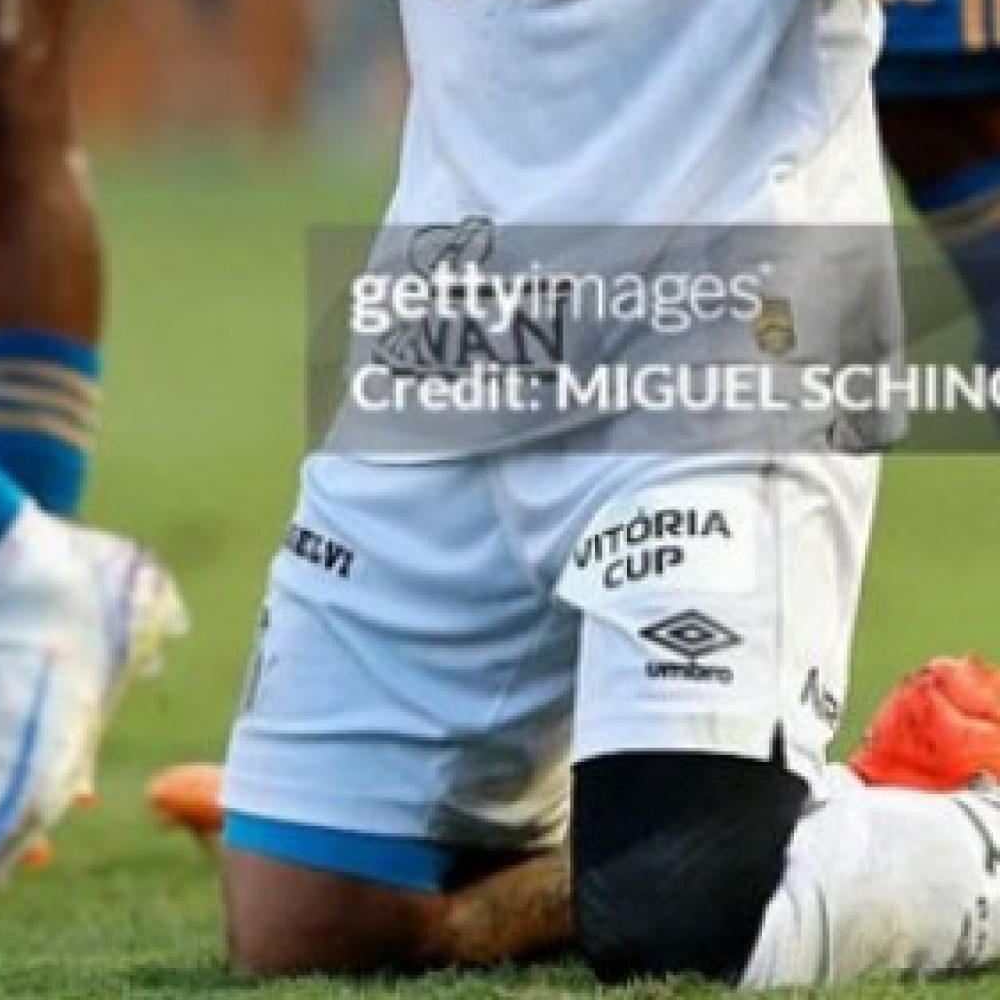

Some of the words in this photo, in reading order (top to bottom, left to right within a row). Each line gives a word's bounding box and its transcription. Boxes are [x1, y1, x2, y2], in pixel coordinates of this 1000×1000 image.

[574, 508, 732, 569] VITÓRIA
[603, 546, 684, 589] CUP
[645, 660, 735, 685] umbro
